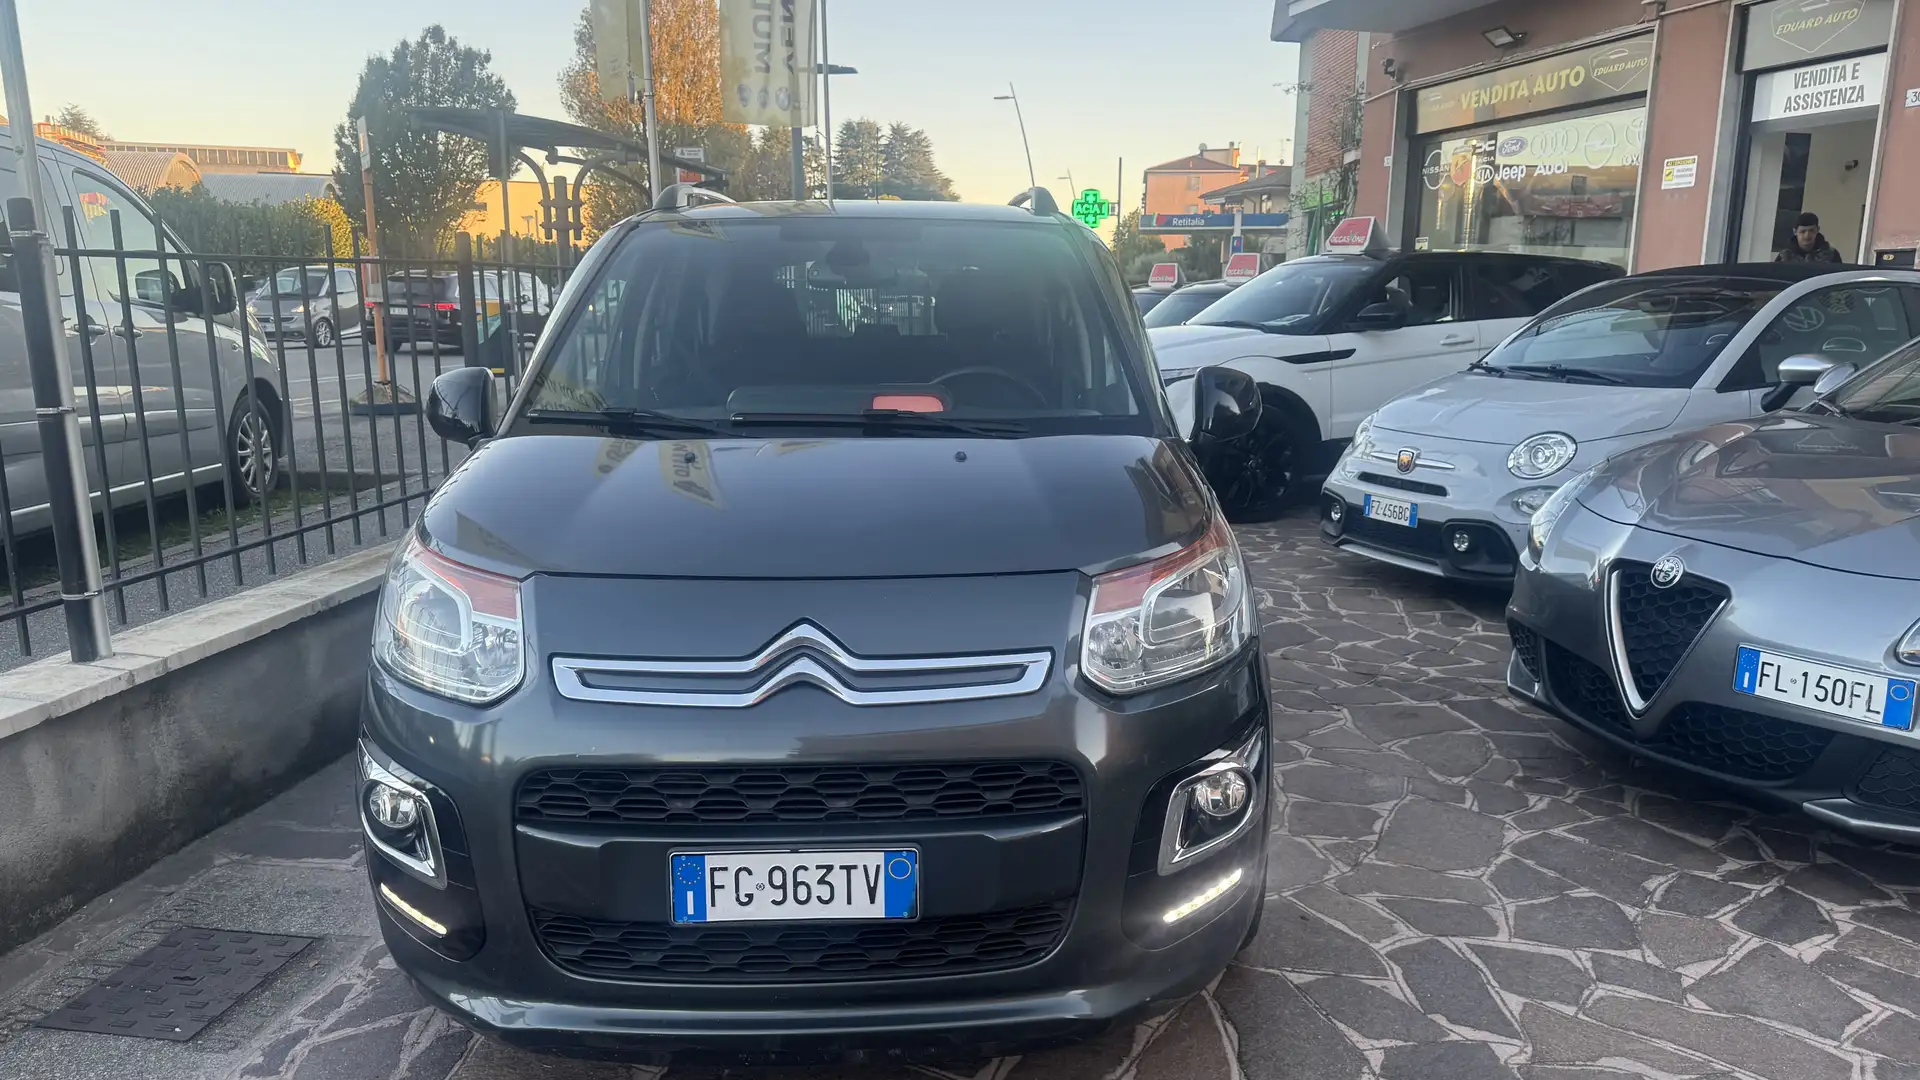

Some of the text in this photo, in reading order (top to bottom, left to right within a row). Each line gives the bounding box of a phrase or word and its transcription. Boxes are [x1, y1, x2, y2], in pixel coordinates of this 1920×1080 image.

[1776, 8, 1859, 35] EDUARD AUTO
[1593, 57, 1648, 77] EDUARD AUTO
[1793, 62, 1861, 90] VENDITA E
[1461, 65, 1586, 111] VENDITA AUTO
[1783, 85, 1865, 113] ASSISTENZA
[1501, 139, 1521, 154] Ford
[1494, 163, 1526, 182] Jeep
[1172, 217, 1205, 226] Retitalia
